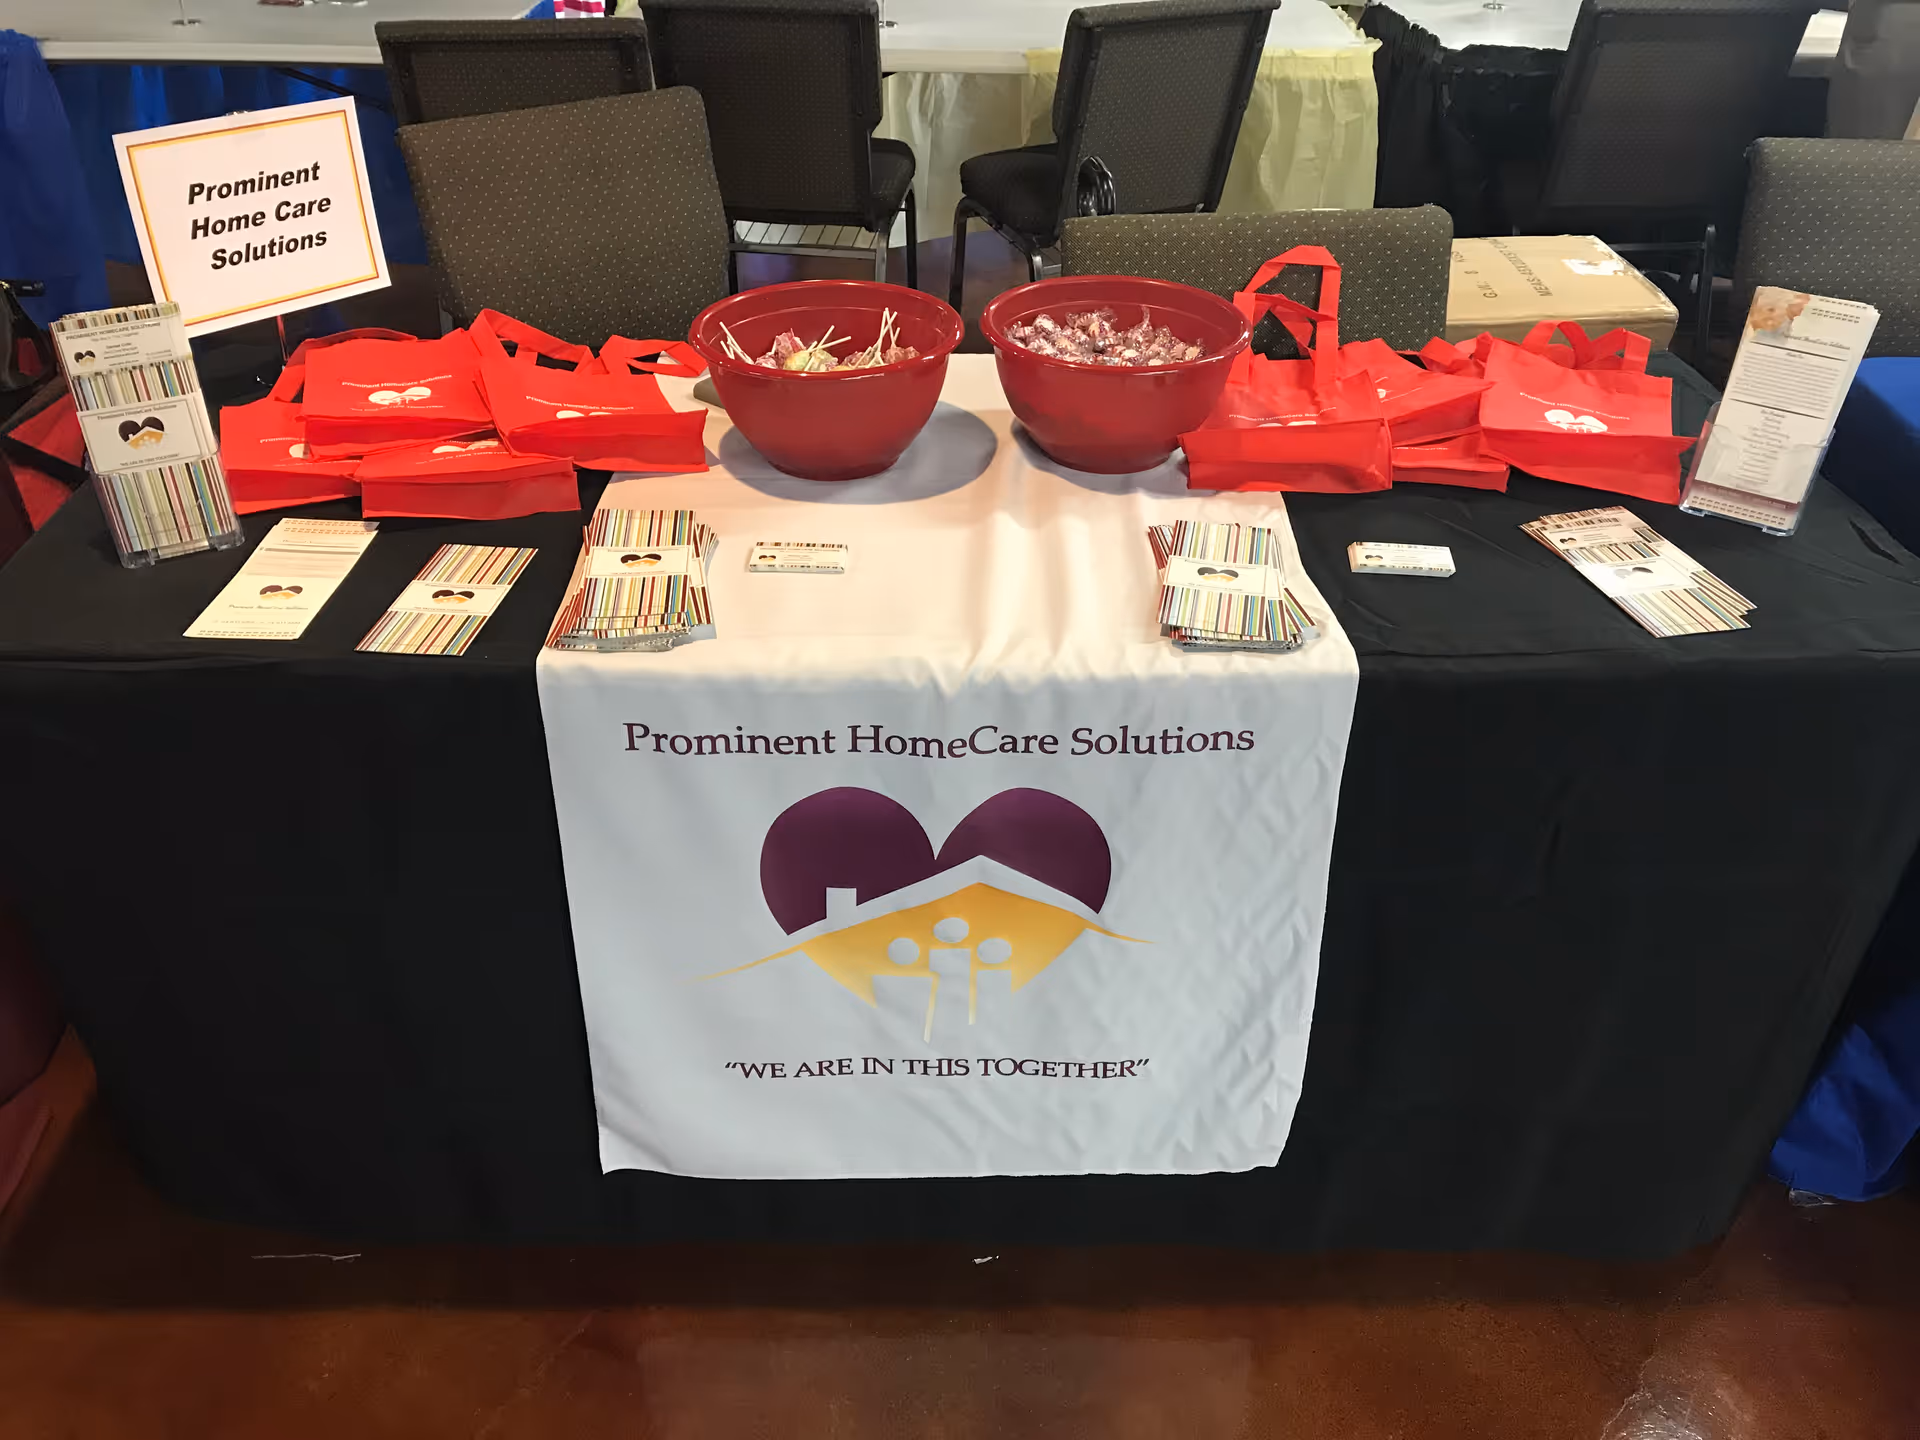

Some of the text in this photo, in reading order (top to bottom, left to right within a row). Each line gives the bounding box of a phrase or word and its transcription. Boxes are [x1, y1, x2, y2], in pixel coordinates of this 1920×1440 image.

[188, 161, 320, 205] Prominent
[190, 197, 331, 240] Home Care
[210, 230, 327, 270] Solutions
[622, 722, 1255, 760] Prominent HomeCare Solutions
[793, 1058, 854, 1078] ARE
[861, 1057, 896, 1075] IN
[902, 1058, 970, 1077] THIS
